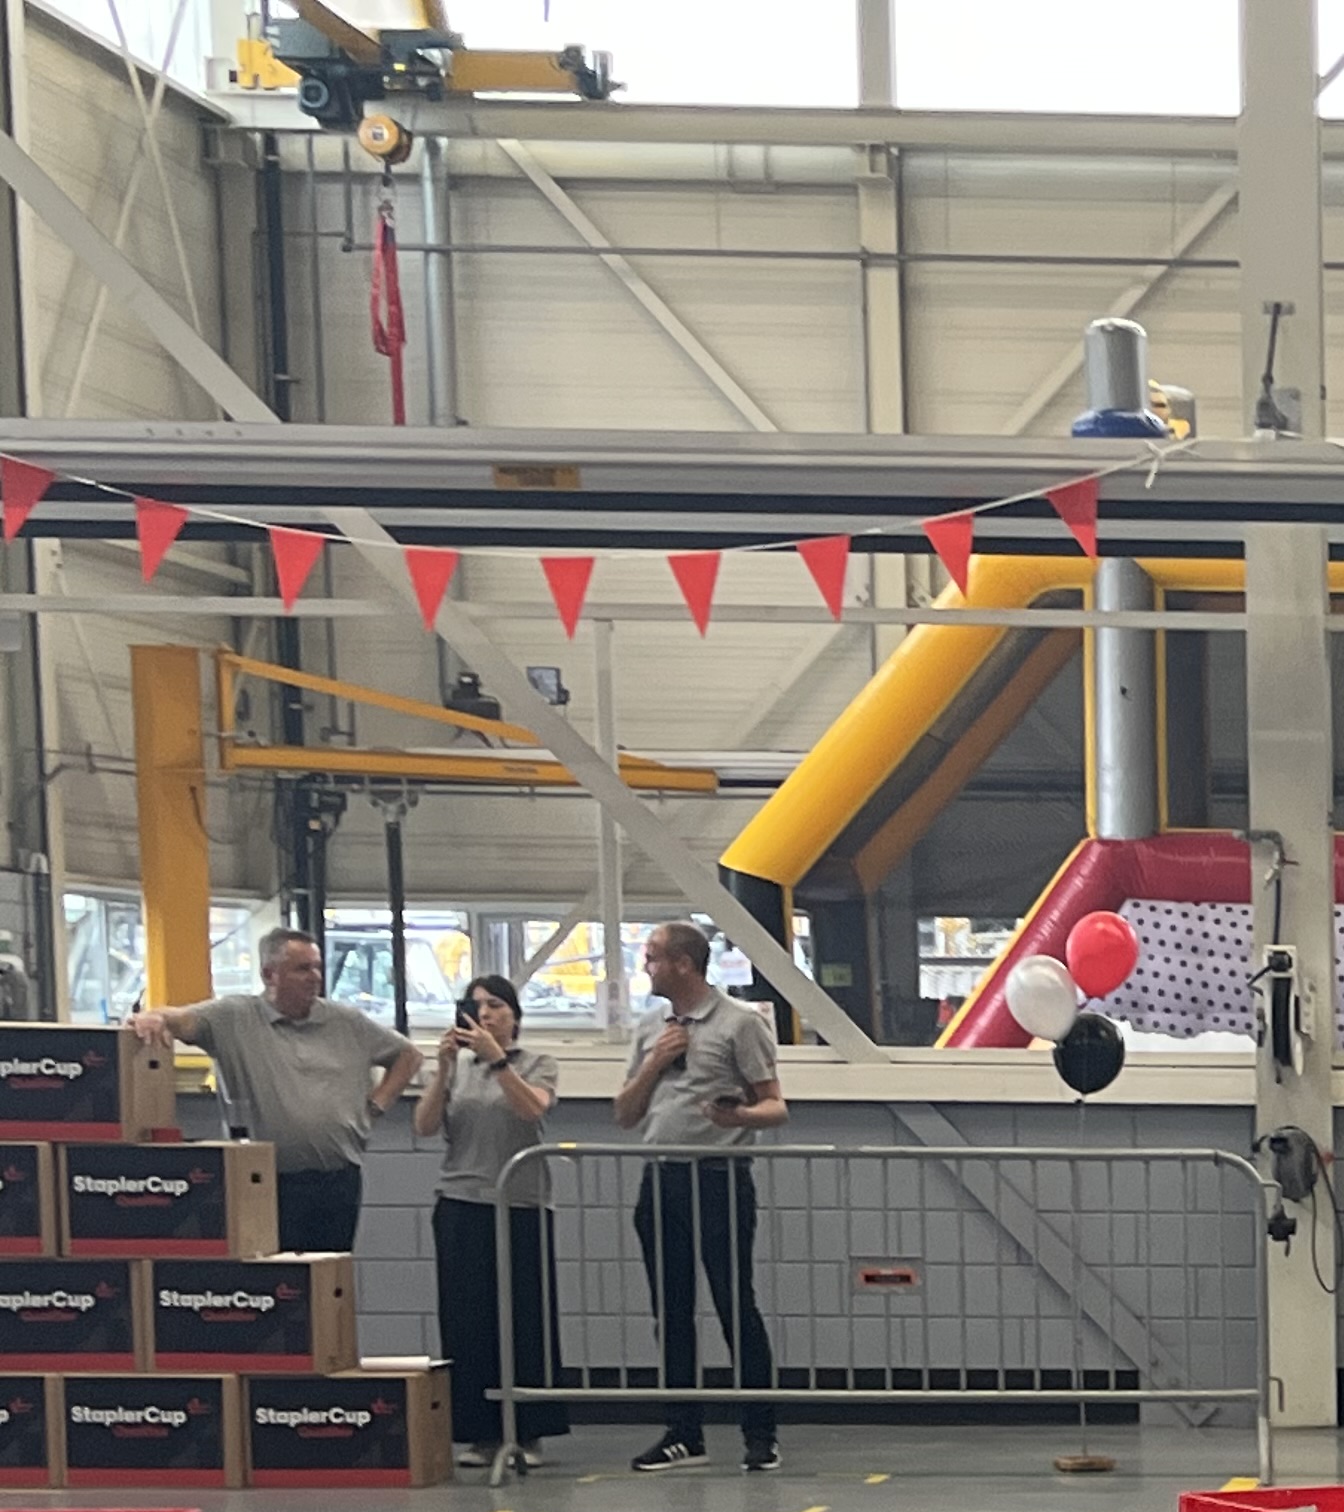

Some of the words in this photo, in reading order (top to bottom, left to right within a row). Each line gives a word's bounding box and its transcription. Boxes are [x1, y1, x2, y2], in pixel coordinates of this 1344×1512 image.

[0, 1057, 83, 1079] plerCup
[73, 1174, 190, 1197] StaplerCup
[0, 1290, 96, 1312] aplerCup
[159, 1289, 276, 1312] StaplerCup
[71, 1405, 188, 1428] StaplerCup
[255, 1407, 372, 1429] StaplerCup
